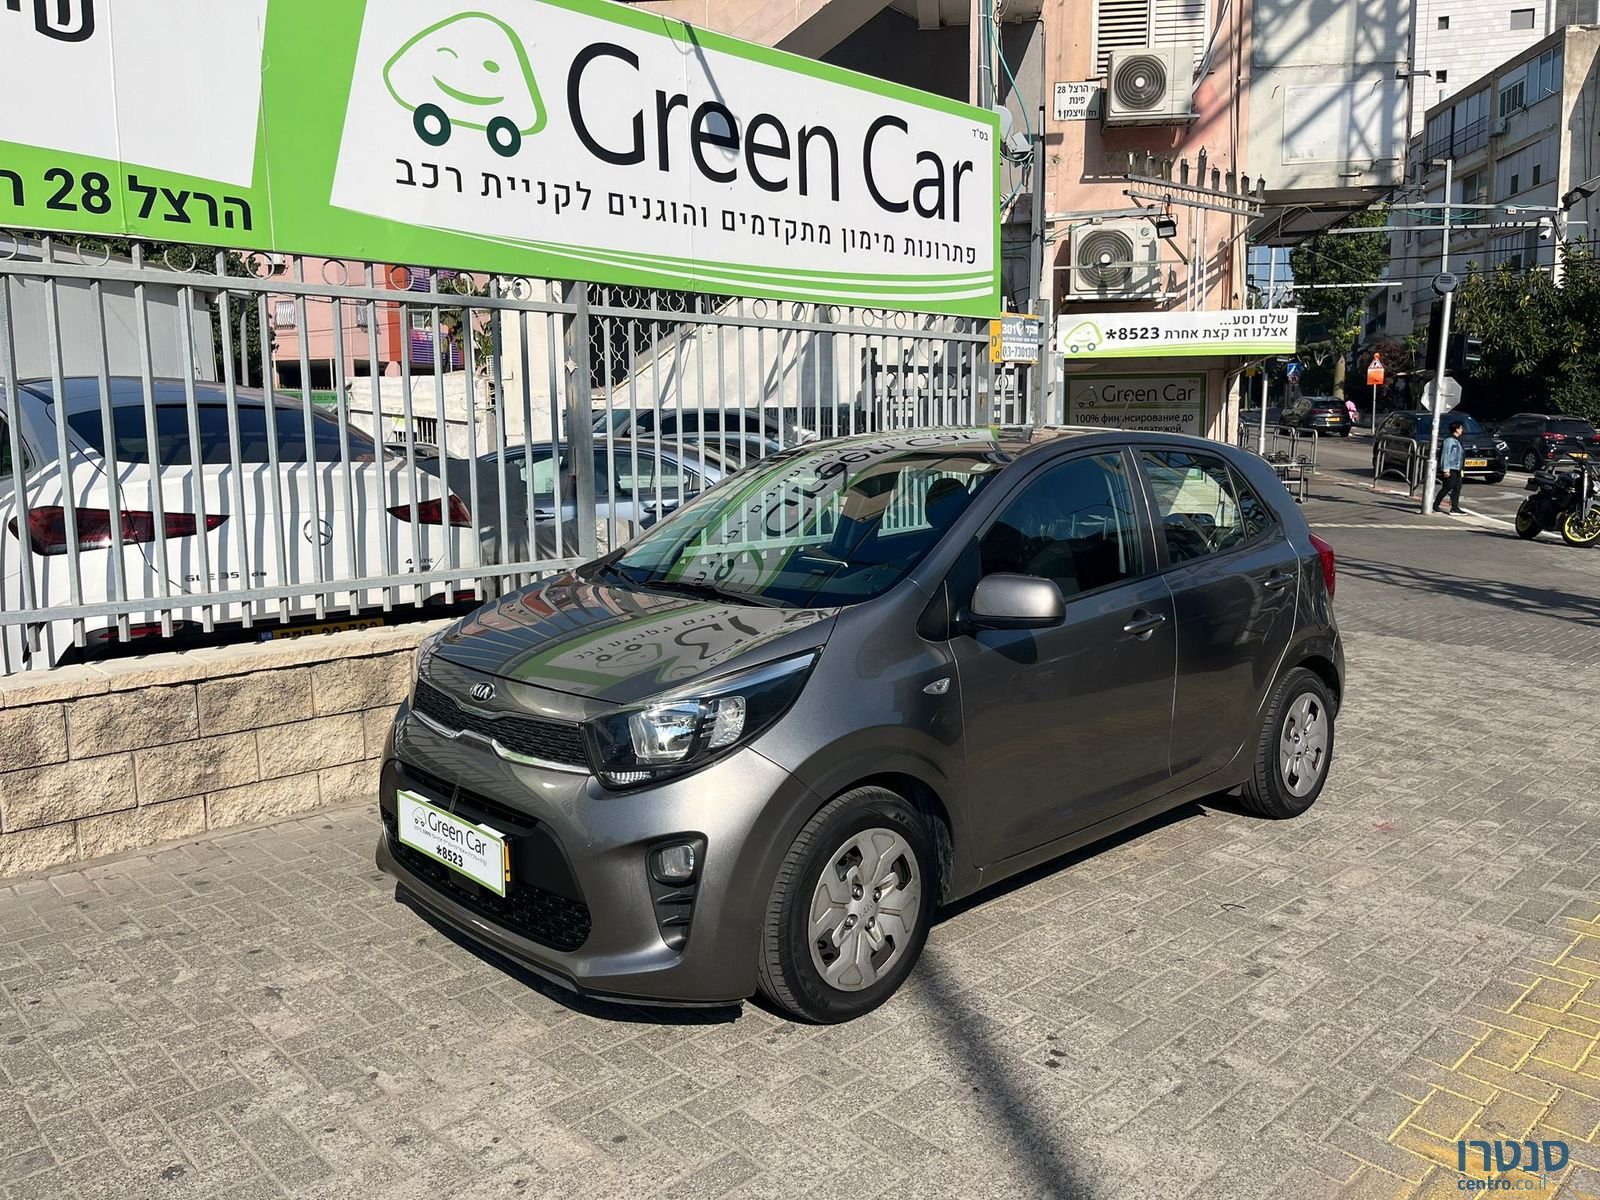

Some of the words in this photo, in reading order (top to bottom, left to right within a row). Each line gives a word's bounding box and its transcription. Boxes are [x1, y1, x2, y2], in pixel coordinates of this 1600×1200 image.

[1057, 86, 1066, 94] 28
[1068, 84, 1089, 93] הרצל
[1068, 96, 1086, 105] פינת
[566, 41, 840, 202] Green
[862, 114, 973, 223] Car
[395, 158, 463, 193] רכב
[44, 167, 112, 215] 28
[481, 171, 592, 215] לקניית
[127, 174, 253, 231] הרצל
[608, 192, 707, 228] והוגנים
[721, 209, 831, 246] מתקדמים
[842, 227, 895, 254] מימון
[903, 237, 976, 264] פתרונות
[1219, 315, 1255, 326] וסע...
[1259, 313, 1289, 324] שלם
[1164, 329, 1199, 339] אחרת
[1202, 328, 1230, 340] קצת
[1234, 327, 1248, 337] זה
[1252, 325, 1288, 337] אצלנו
[1101, 385, 1158, 402] Green
[1162, 383, 1196, 401] Car
[1075, 414, 1100, 424] 100%
[1101, 412, 1180, 424] финнсирование
[1181, 414, 1194, 423] до
[428, 811, 464, 845] Green
[466, 830, 487, 856] Car
